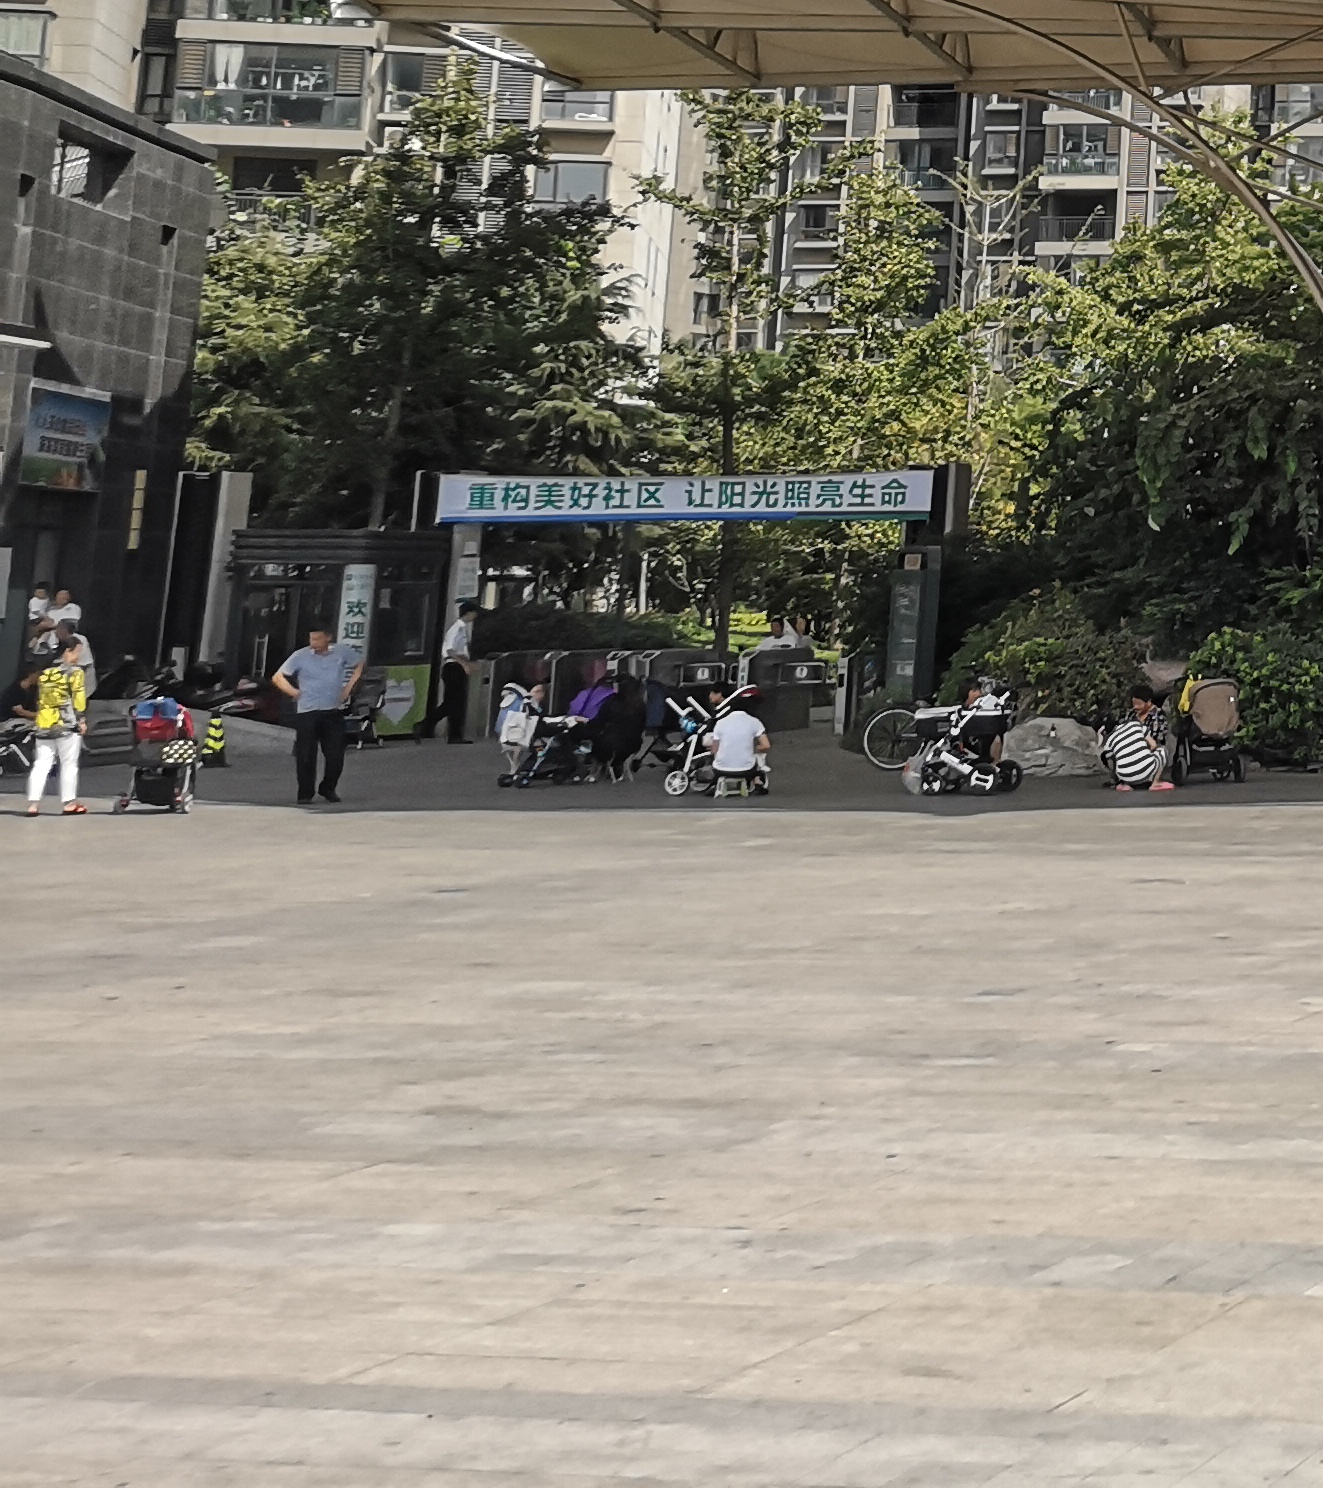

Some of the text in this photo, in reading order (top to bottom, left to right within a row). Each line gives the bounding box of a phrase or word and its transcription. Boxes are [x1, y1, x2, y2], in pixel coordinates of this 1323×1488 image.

[466, 478, 909, 511] 重构美好社区 让阳光照亮生命
